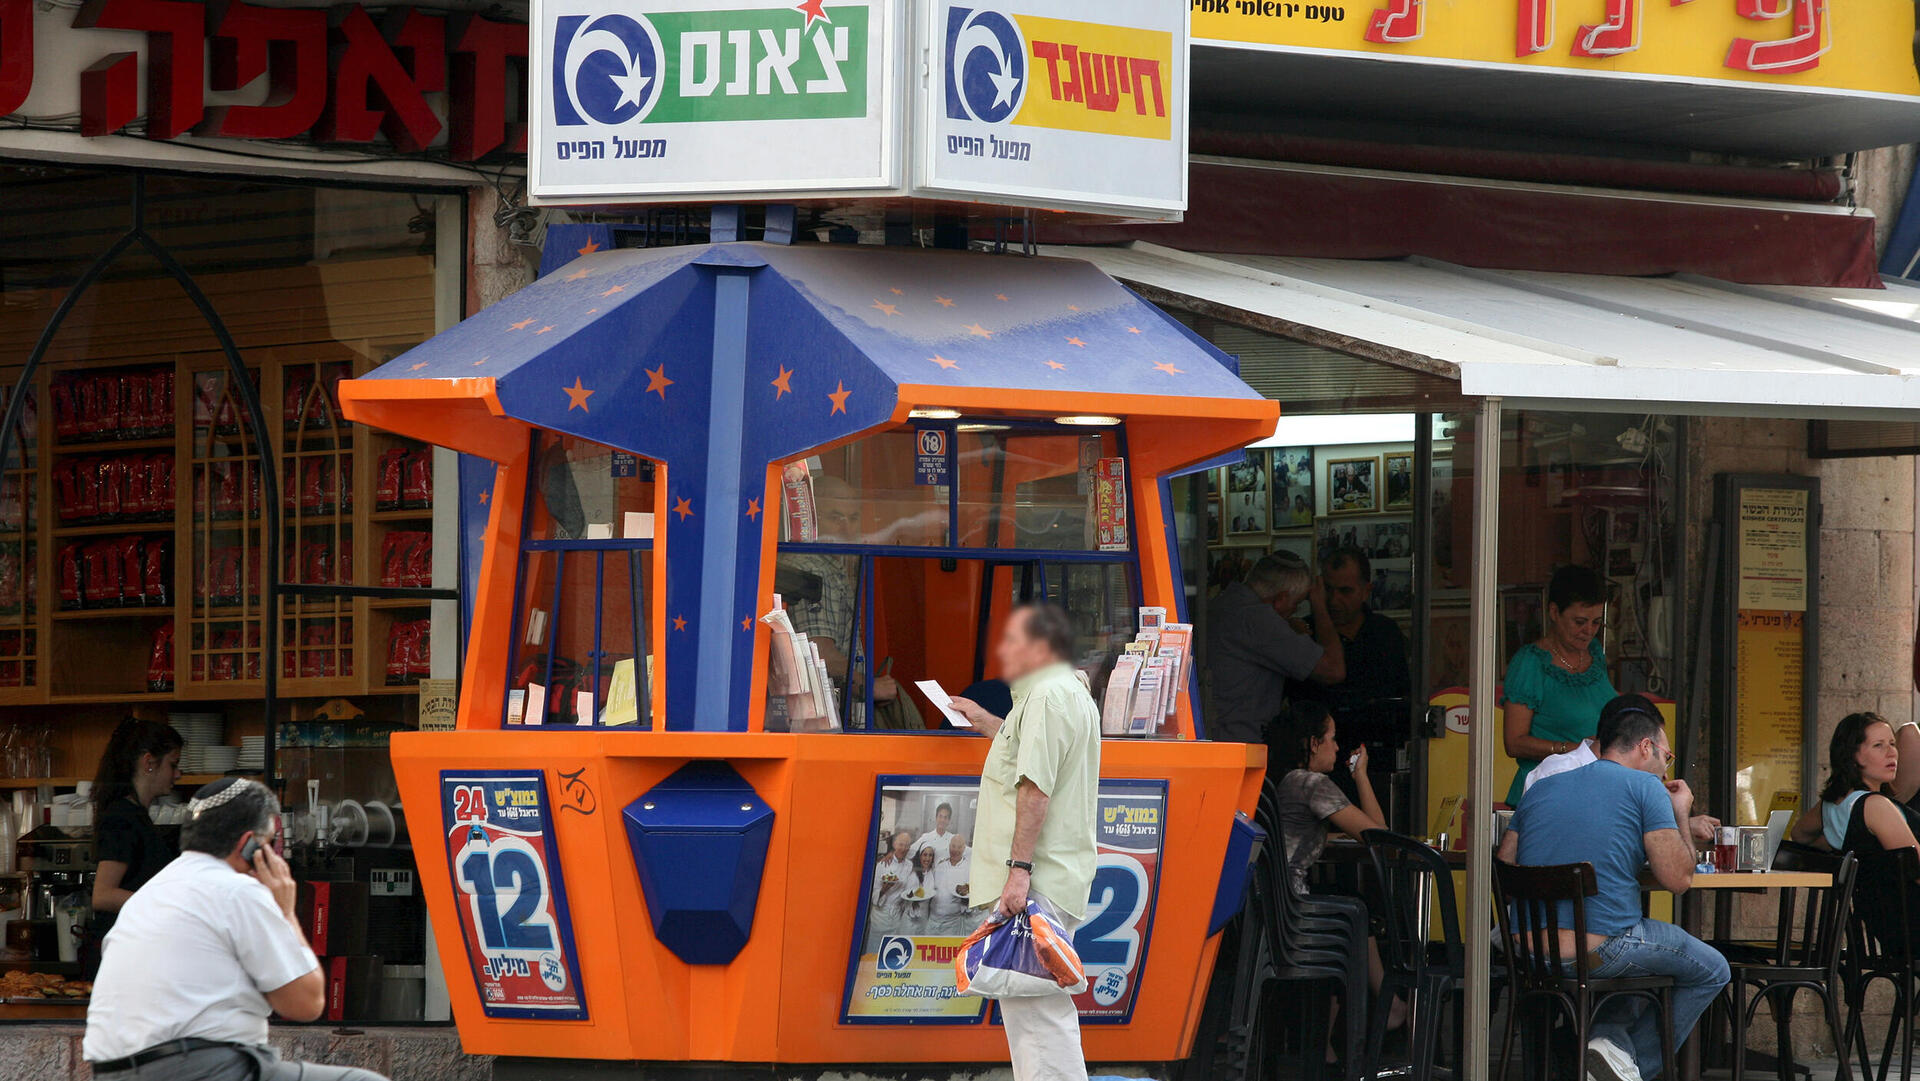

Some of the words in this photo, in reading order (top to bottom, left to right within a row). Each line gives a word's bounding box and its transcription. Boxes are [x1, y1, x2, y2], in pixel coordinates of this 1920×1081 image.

[1190, 0, 1229, 14] אמי
[1235, 0, 1299, 18] ירושלמי
[1305, 5, 1345, 23] טעם
[1031, 40, 1166, 118] חישגד
[557, 141, 604, 160] הפיס
[612, 136, 667, 159] מפעל
[946, 134, 985, 157] הפיס
[989, 134, 1032, 162] מפעל
[925, 435, 939, 452] 18
[1454, 714, 1470, 726] שר
[454, 786, 488, 822] 24
[495, 788, 538, 806] במוצ"ש
[1104, 805, 1158, 823] במוצ"ש
[1104, 825, 1115, 834] עד
[1132, 825, 1157, 835] בדאבל
[462, 848, 555, 950] 12
[1074, 865, 1139, 966] 2
[916, 945, 960, 964] ישגד
[489, 954, 530, 979] מיליון
[866, 984, 892, 999] כסף.
[893, 983, 923, 998] אחלה
[923, 985, 937, 998] זה
